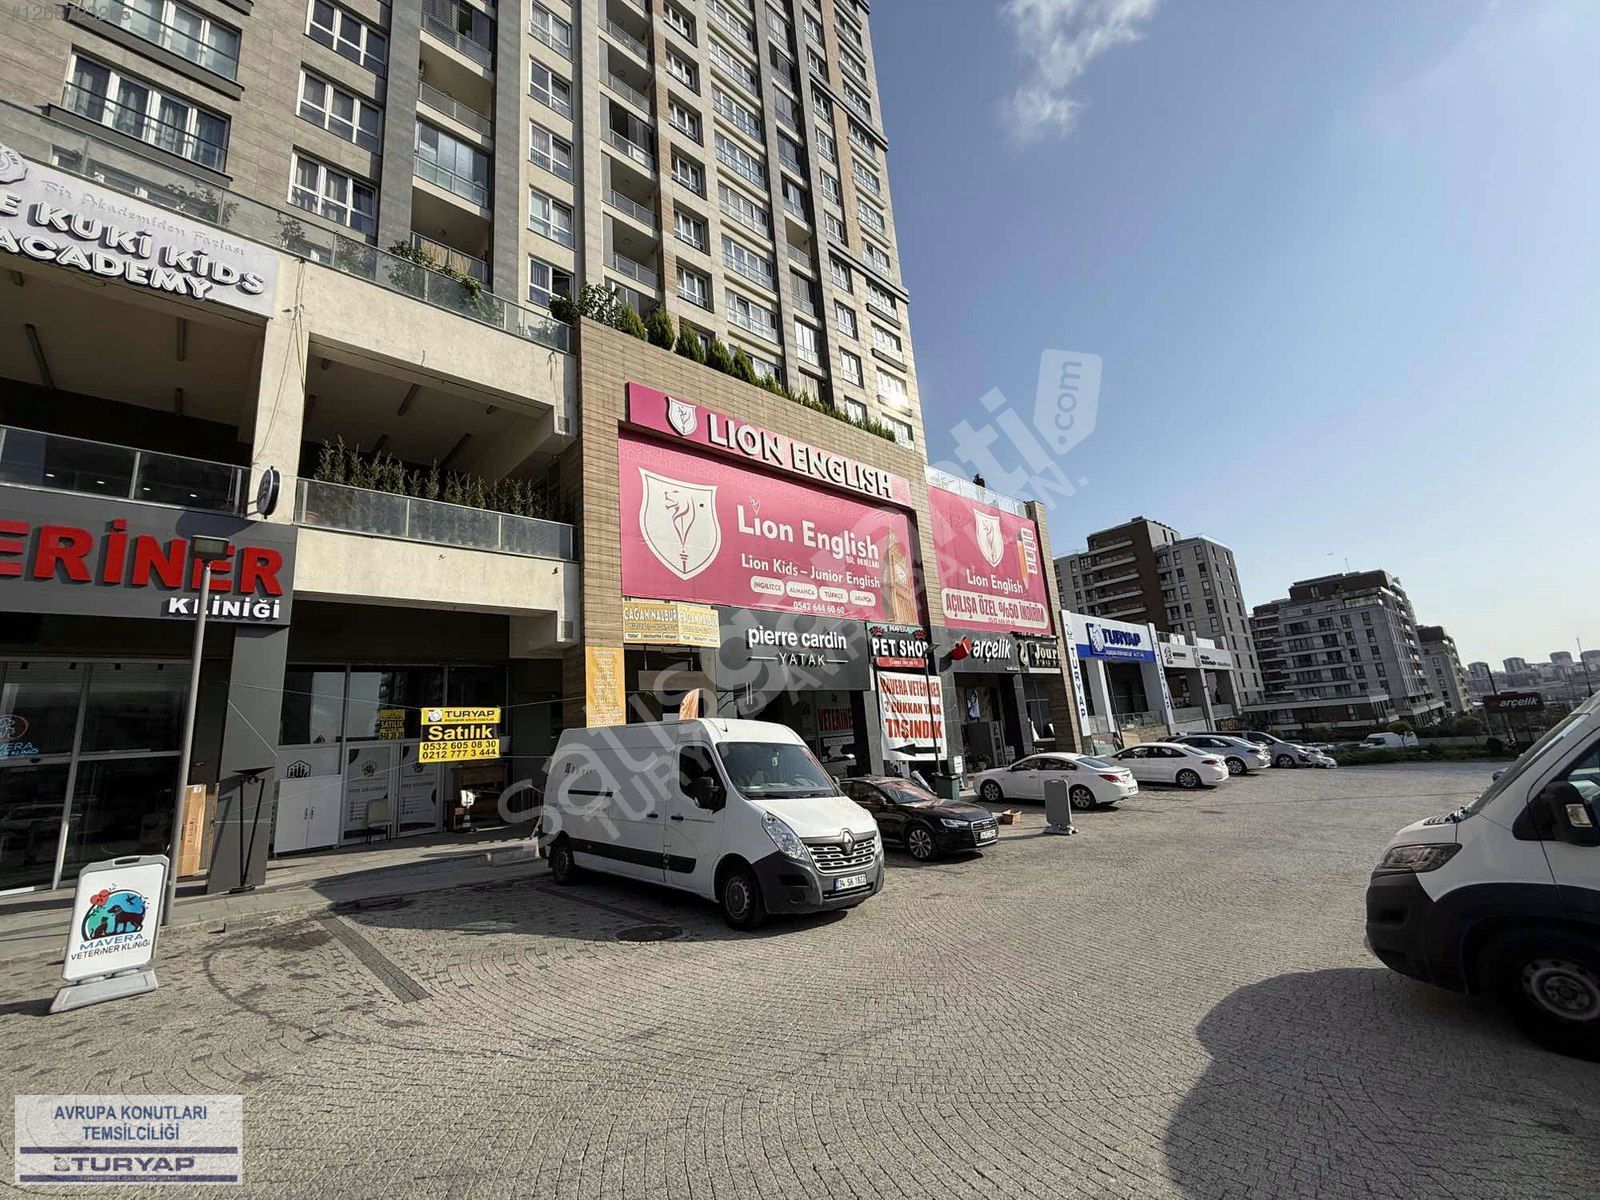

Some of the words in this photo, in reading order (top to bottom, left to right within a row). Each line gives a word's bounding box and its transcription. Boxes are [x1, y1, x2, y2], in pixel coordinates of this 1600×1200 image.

[707, 411, 783, 466] LION
[790, 441, 892, 499] ENGLISH
[737, 504, 795, 543] Lion
[802, 519, 879, 560] English
[741, 552, 769, 571] Lion
[773, 558, 799, 577] Kids
[810, 566, 843, 583] Junior
[846, 571, 881, 590] English
[966, 568, 989, 587] Lion
[990, 574, 1024, 595] English
[168, 595, 280, 619] KLİNİĞİ
[978, 594, 998, 617] ÖZEL
[998, 601, 1019, 619] %50
[747, 625, 798, 648] pierre
[801, 627, 848, 650] cardin
[872, 637, 896, 656] PET
[899, 639, 929, 657] SHOP
[779, 652, 826, 666] YATAK
[973, 638, 1011, 662] arçelik
[445, 710, 495, 718] TURYAP
[1500, 697, 1538, 709] arçelik
[428, 725, 493, 741] Satılık
[422, 751, 448, 760] 0212
[451, 749, 468, 758] 777
[470, 749, 477, 757] 3
[479, 748, 497, 756] 444
[423, 742, 448, 751] 0532
[451, 741, 469, 750] 605
[471, 741, 483, 749] 08
[485, 740, 497, 748] 30
[79, 933, 144, 951] MAVERA
